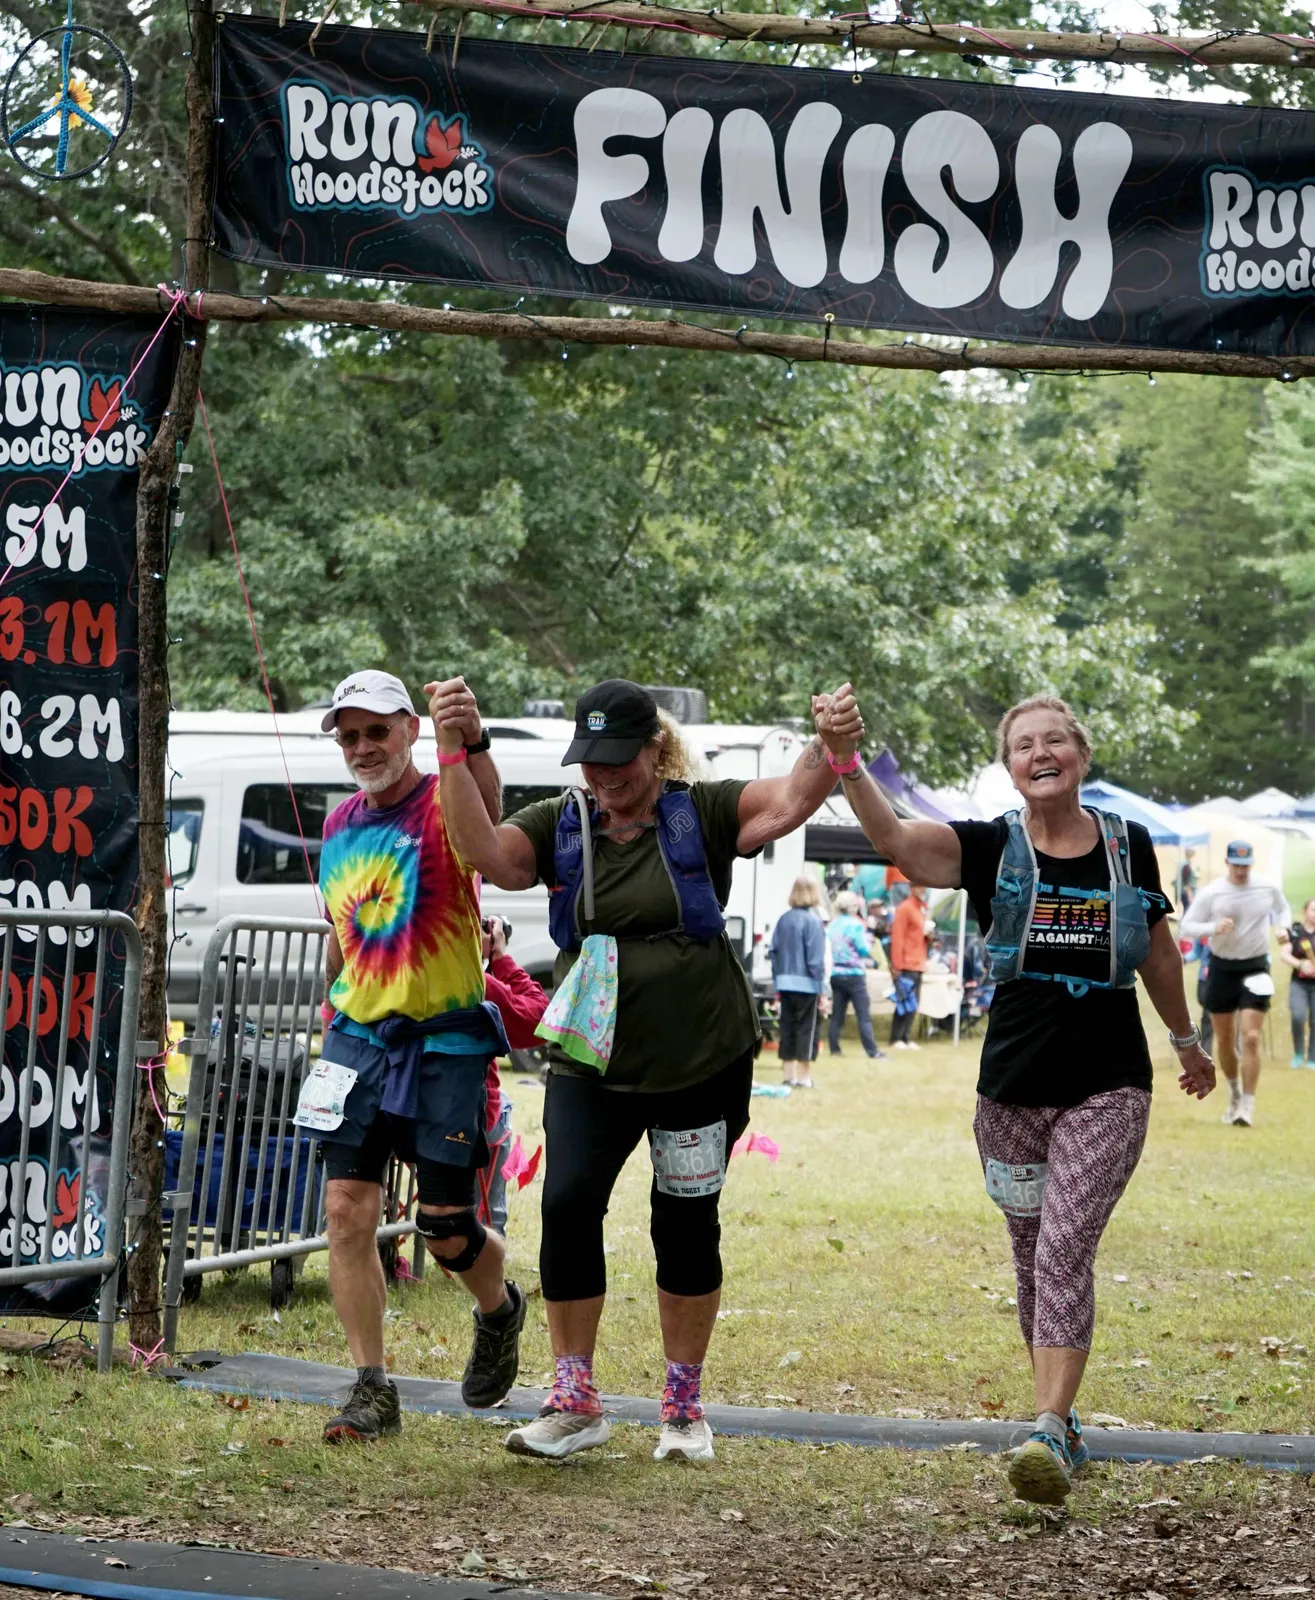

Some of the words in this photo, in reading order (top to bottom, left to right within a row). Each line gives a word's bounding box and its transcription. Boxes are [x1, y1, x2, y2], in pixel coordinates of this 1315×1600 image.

[286, 85, 418, 167] Run
[292, 160, 488, 213] Woodstock
[565, 87, 1133, 321] FINISH
[0, 367, 82, 430] un
[5, 502, 88, 572] 5M
[662, 1143, 717, 1175] 1361
